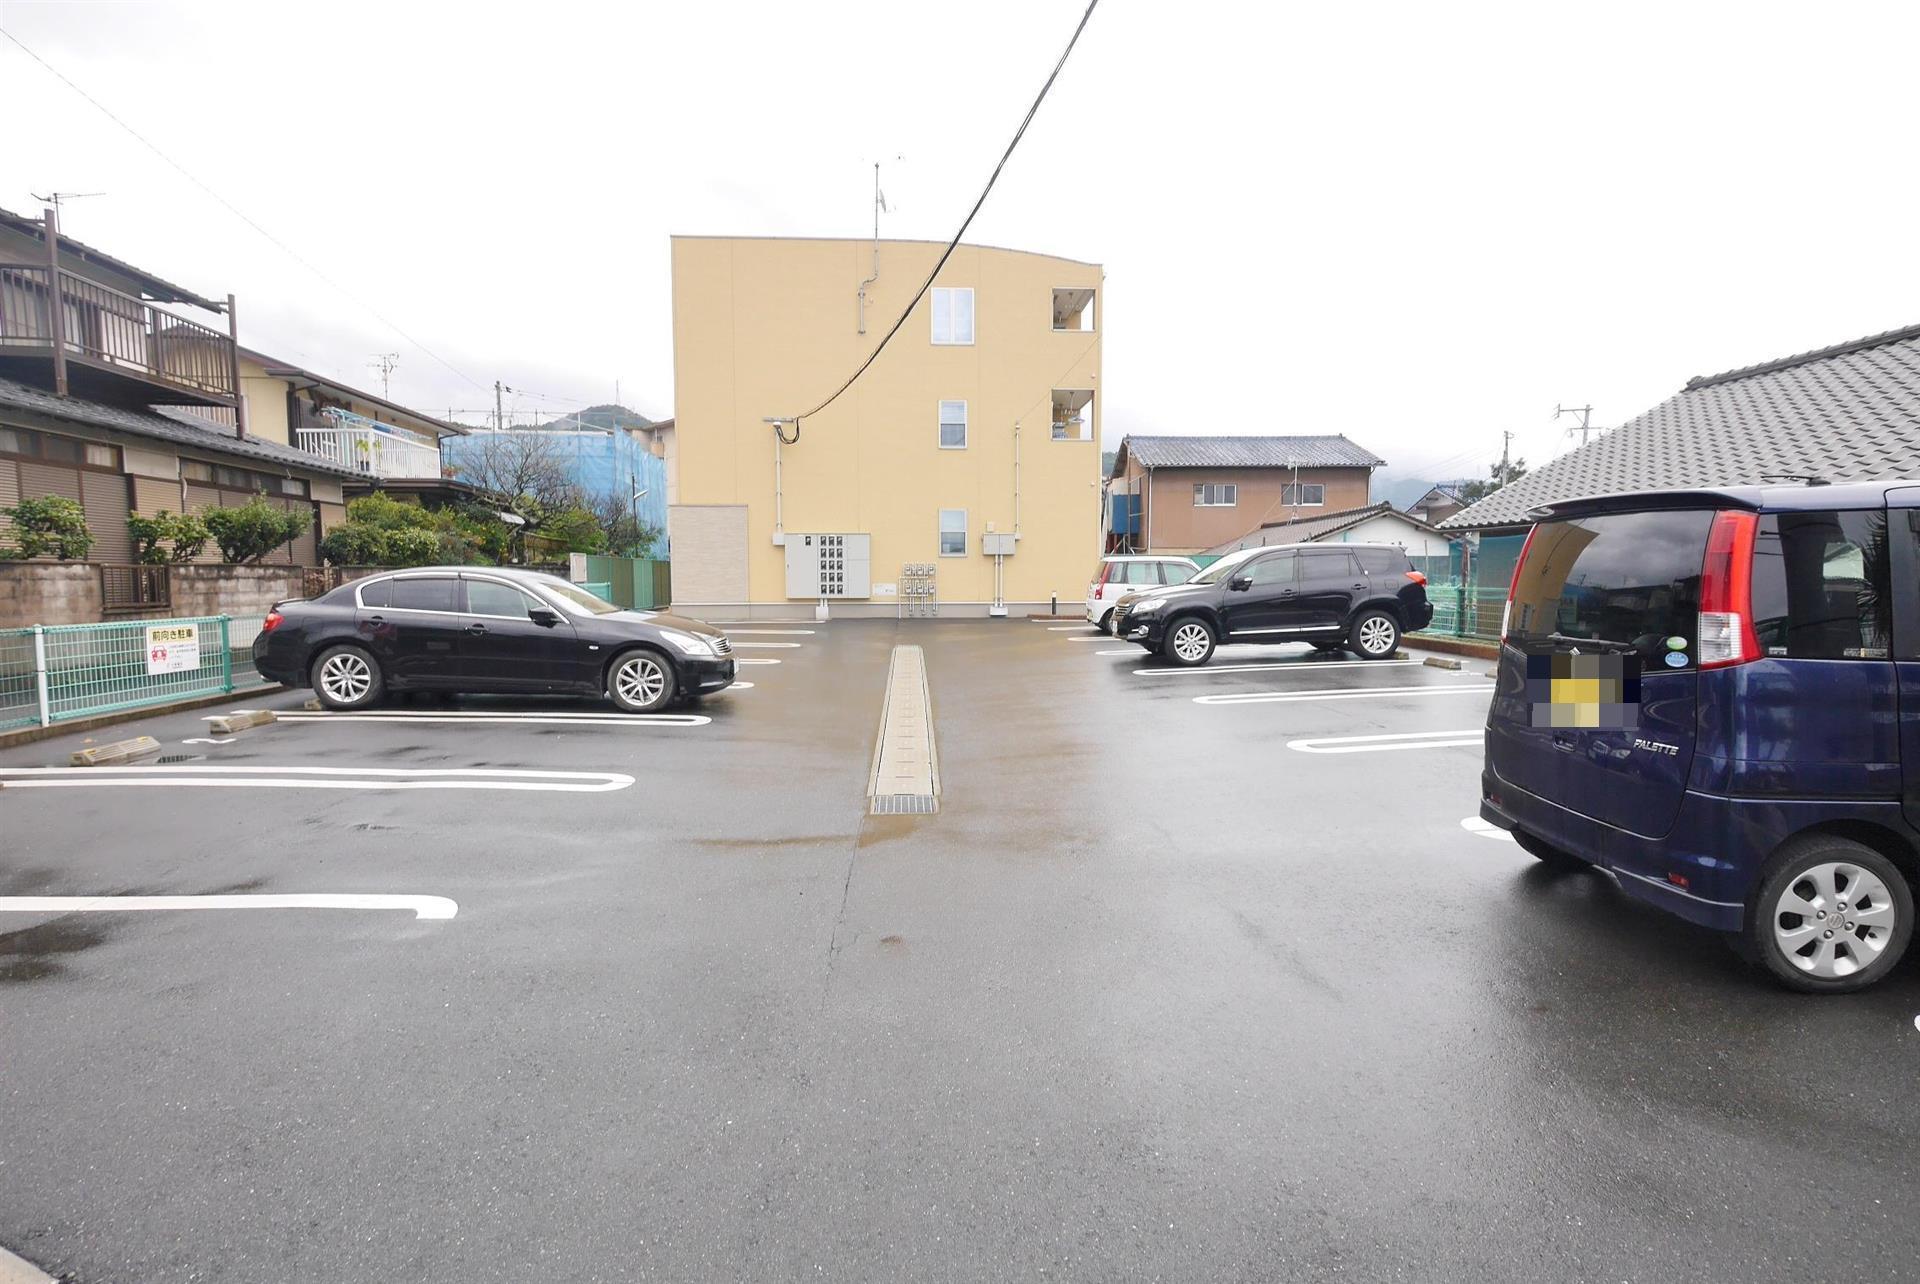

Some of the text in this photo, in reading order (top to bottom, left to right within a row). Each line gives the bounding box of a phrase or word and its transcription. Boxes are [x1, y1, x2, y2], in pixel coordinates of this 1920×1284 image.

[152, 628, 193, 641] 前向き駐車
[1633, 738, 1679, 756] PALETTE
